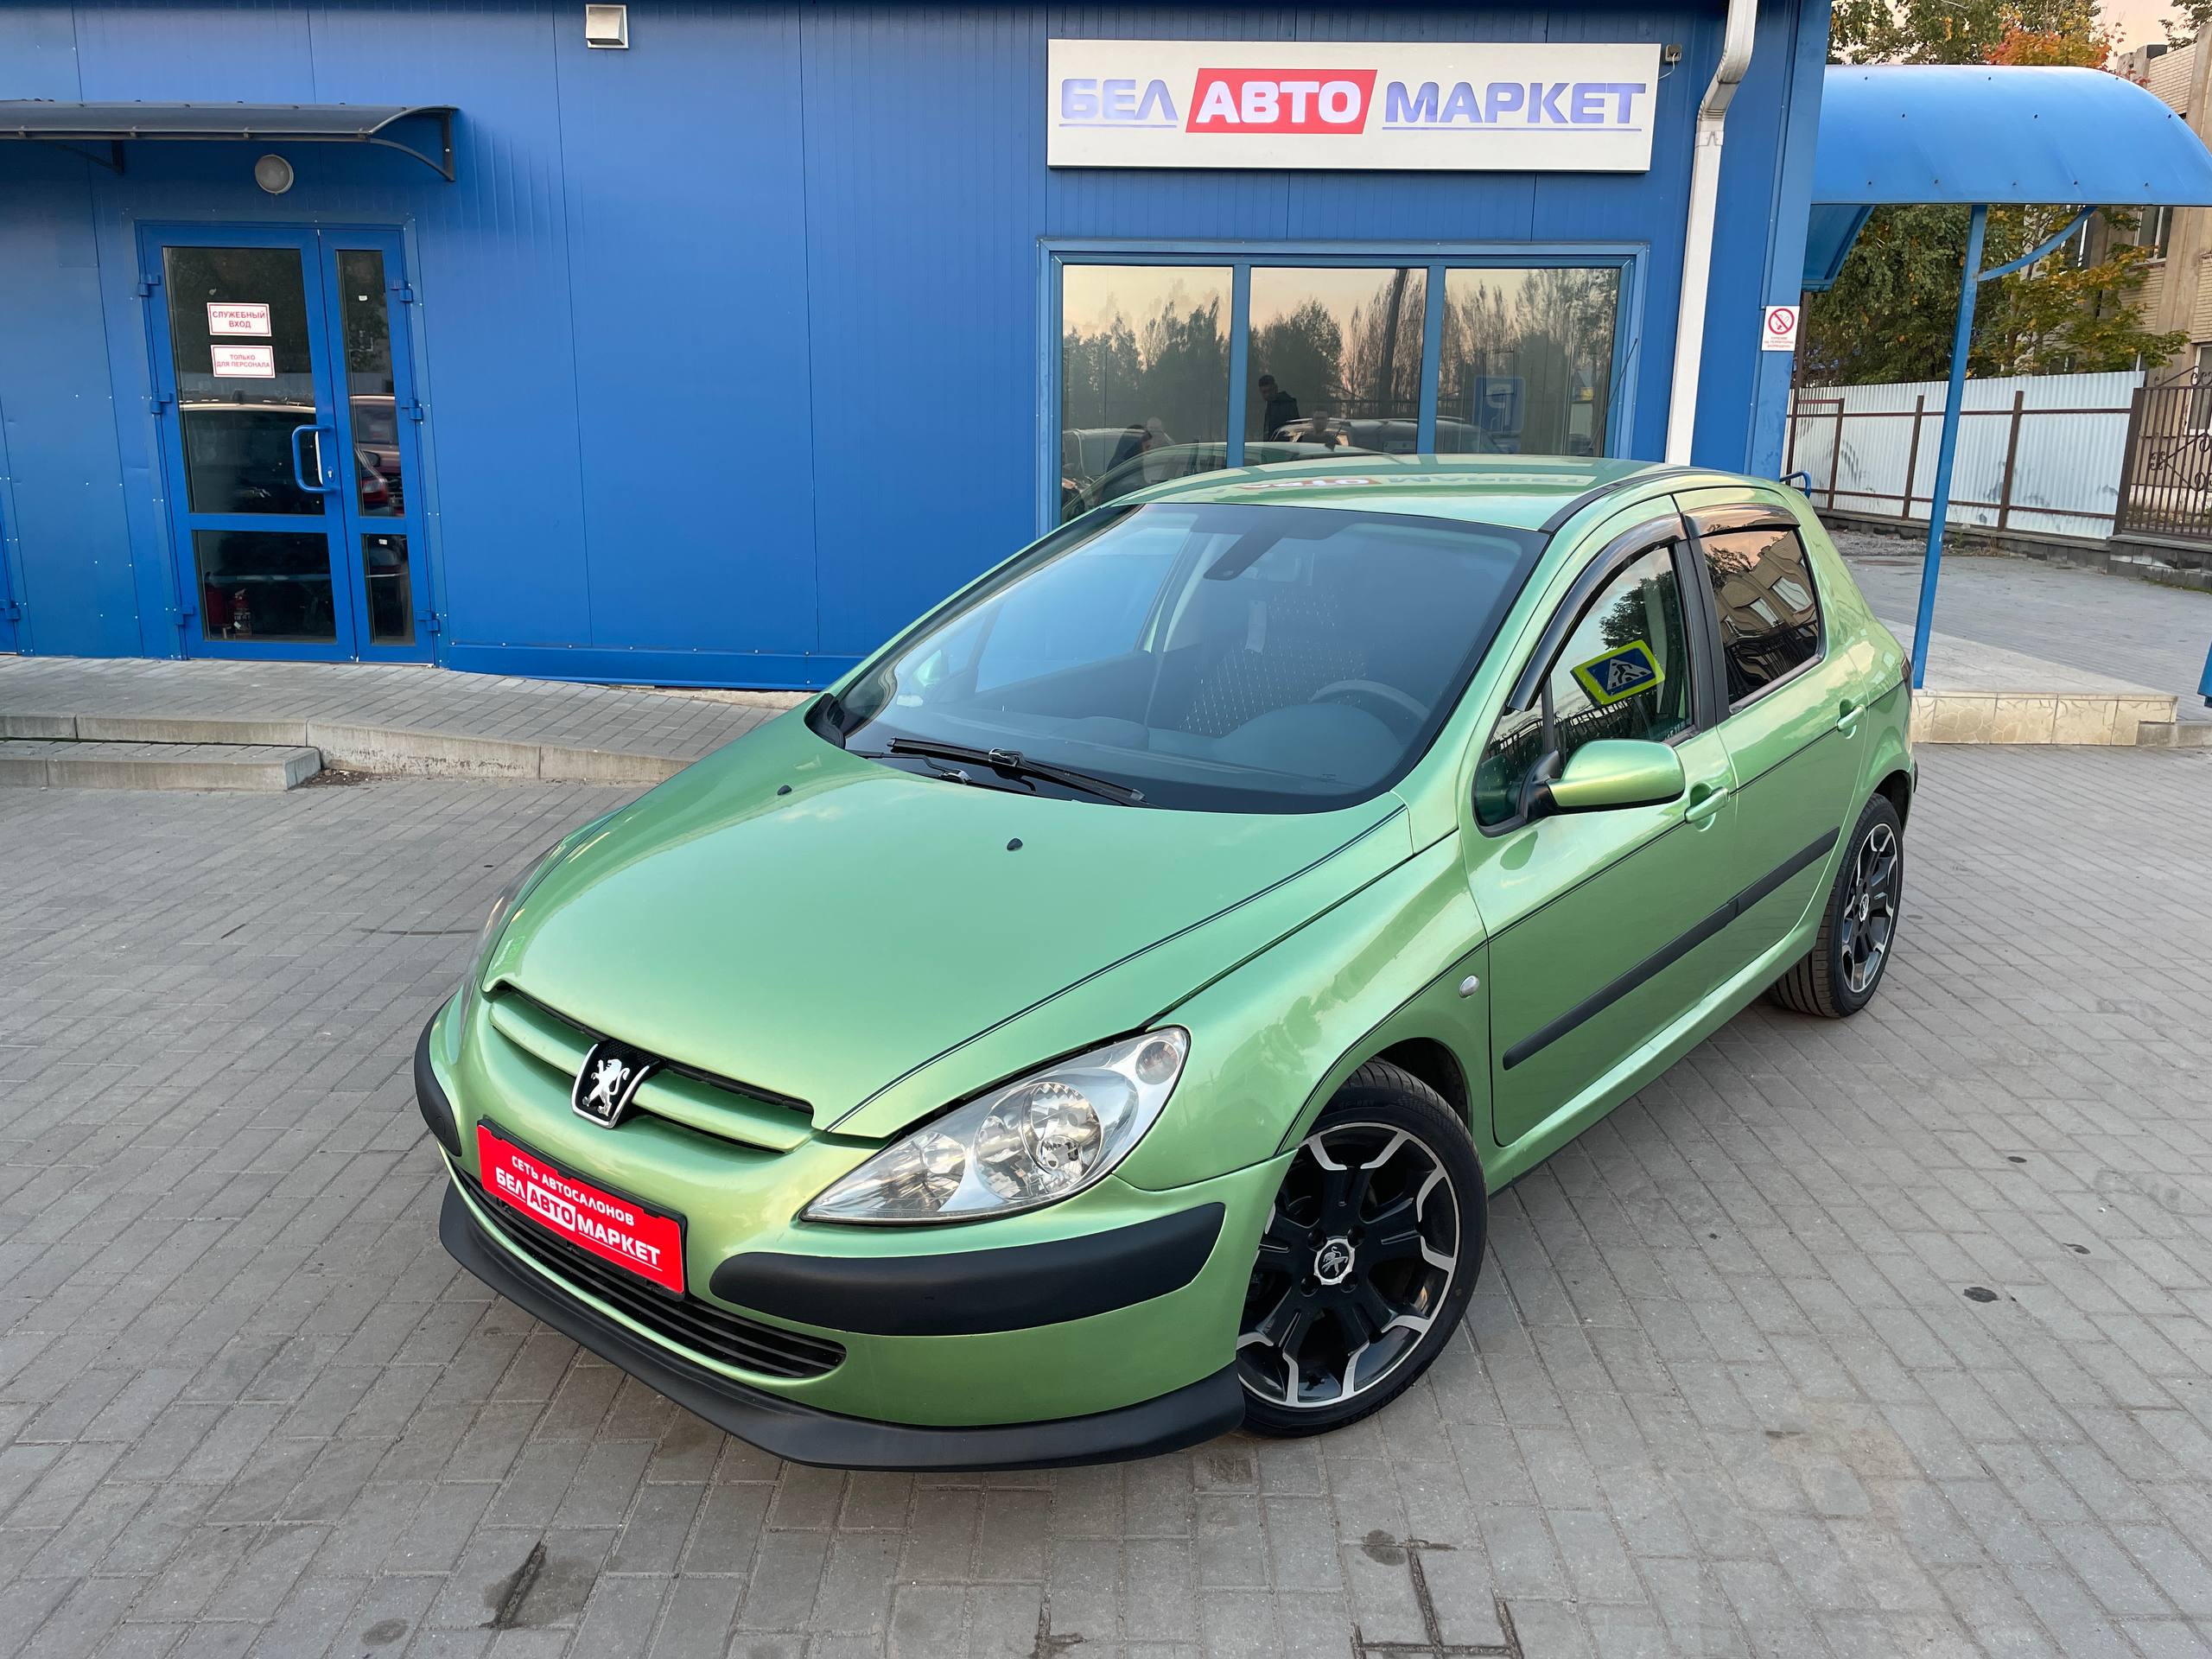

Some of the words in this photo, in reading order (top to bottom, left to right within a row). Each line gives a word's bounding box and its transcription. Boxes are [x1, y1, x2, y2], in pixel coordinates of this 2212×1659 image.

[1060, 79, 1179, 121] БЕЛ
[1196, 81, 1362, 124] АВТО
[1384, 81, 1647, 124] МАРКЕТ
[212, 310, 266, 319] СЛУЖЕБНЫЙ
[496, 1166, 525, 1198] БЕЛ
[531, 1190, 573, 1224] АВТО
[577, 1213, 660, 1265] МАРКЕТ
[512, 1155, 538, 1180] СЕТЬ
[542, 1173, 634, 1226] АВТОСАЛОНОВ
